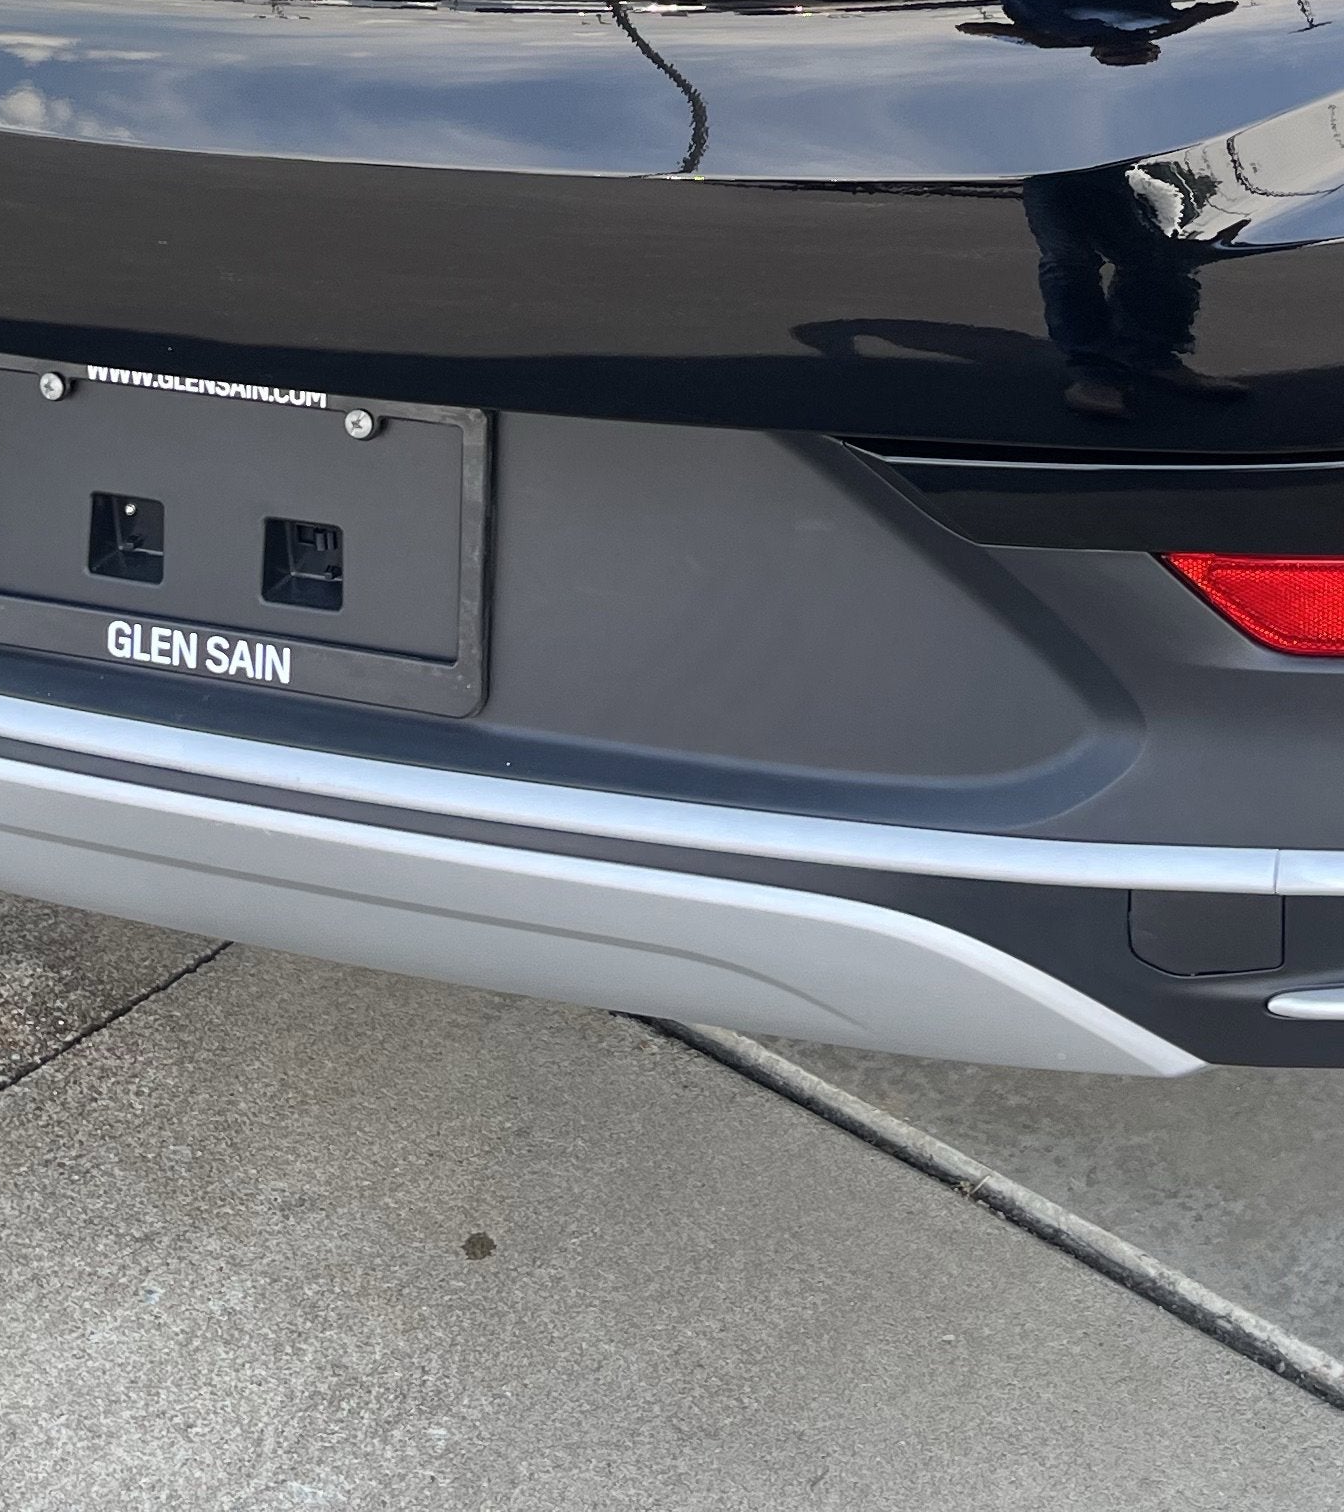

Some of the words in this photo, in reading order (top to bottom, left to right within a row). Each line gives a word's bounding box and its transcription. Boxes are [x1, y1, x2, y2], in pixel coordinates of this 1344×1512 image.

[87, 364, 327, 409] WWW.GLENSAIN.COM
[107, 620, 198, 670] GLEN
[205, 635, 291, 685] SAIN
